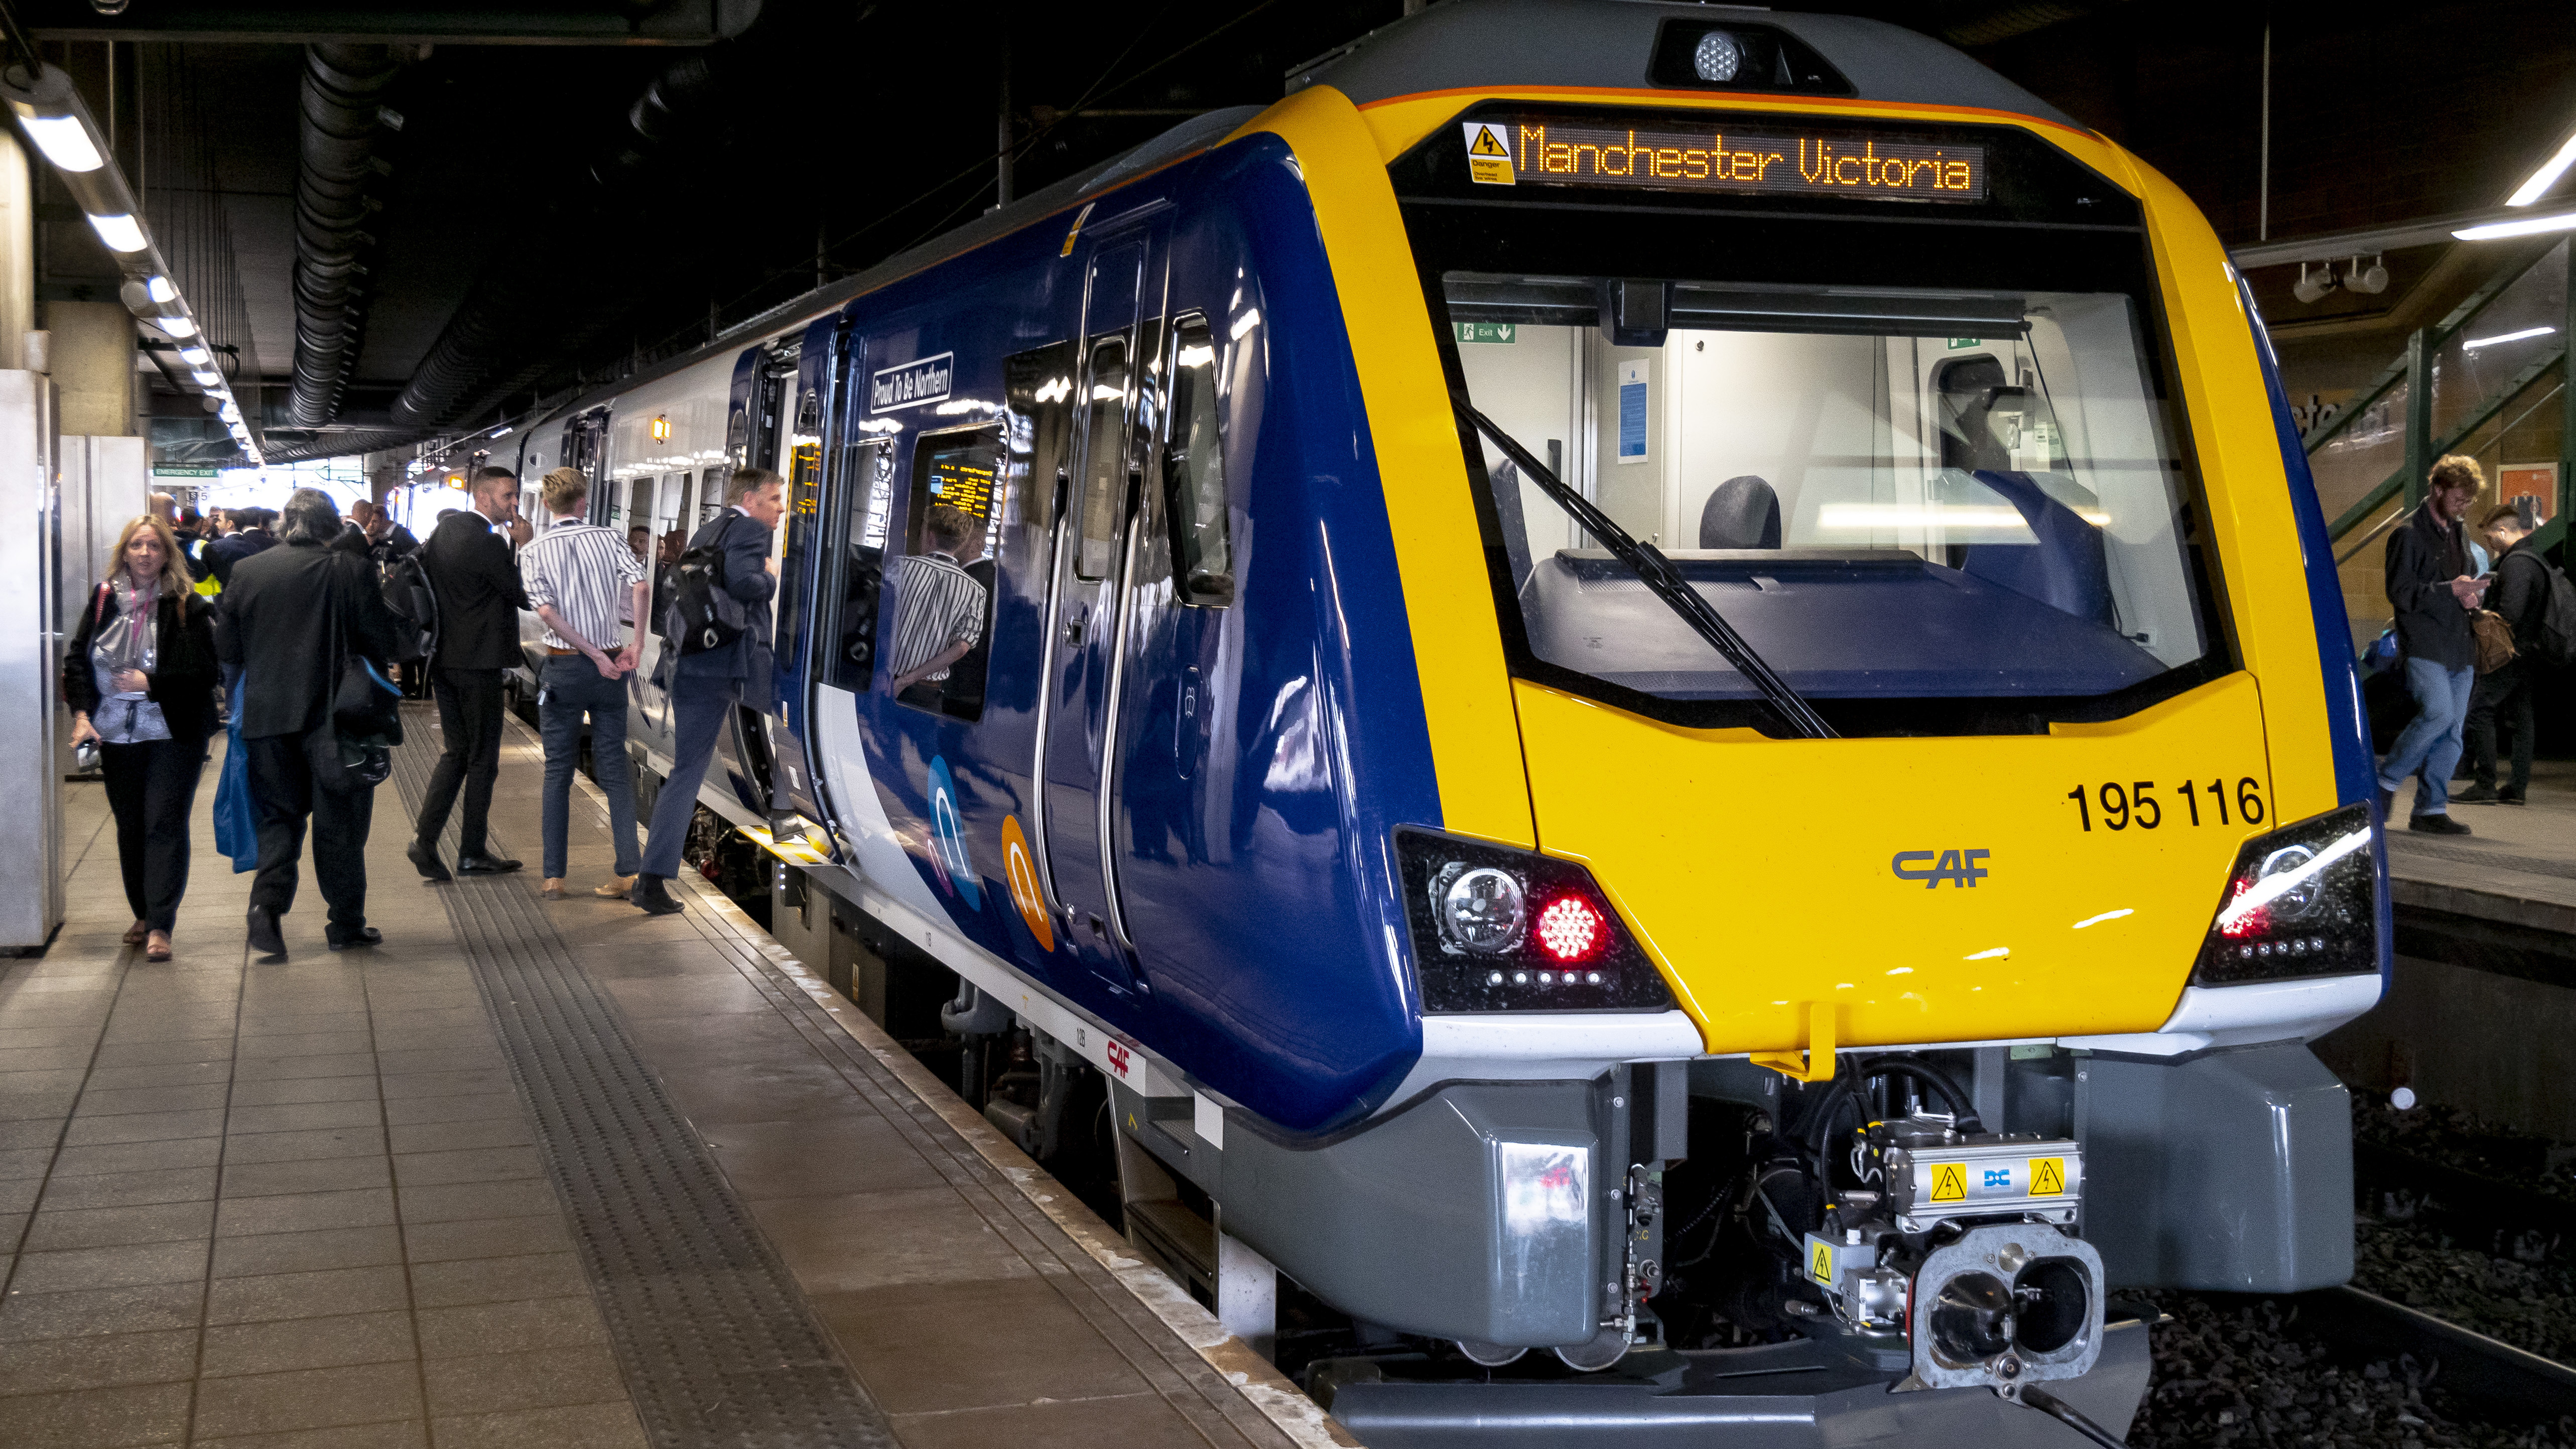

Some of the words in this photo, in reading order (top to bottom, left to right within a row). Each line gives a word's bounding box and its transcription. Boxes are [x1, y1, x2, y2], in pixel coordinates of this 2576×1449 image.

[1472, 160, 1500, 169] Danger
[1520, 125, 1783, 182] Manchester
[1799, 138, 1970, 190] Victoria
[1479, 328, 1493, 336] Exit
[874, 374, 894, 407] Proud
[895, 374, 903, 402] To
[904, 372, 913, 400] Be
[914, 363, 948, 399] Northern
[201, 492, 208, 501] 5
[2068, 781, 2161, 832] 195
[2177, 776, 2265, 827] 116
[1891, 848, 1991, 889] CAF
[1107, 1039, 1130, 1079] CAF
